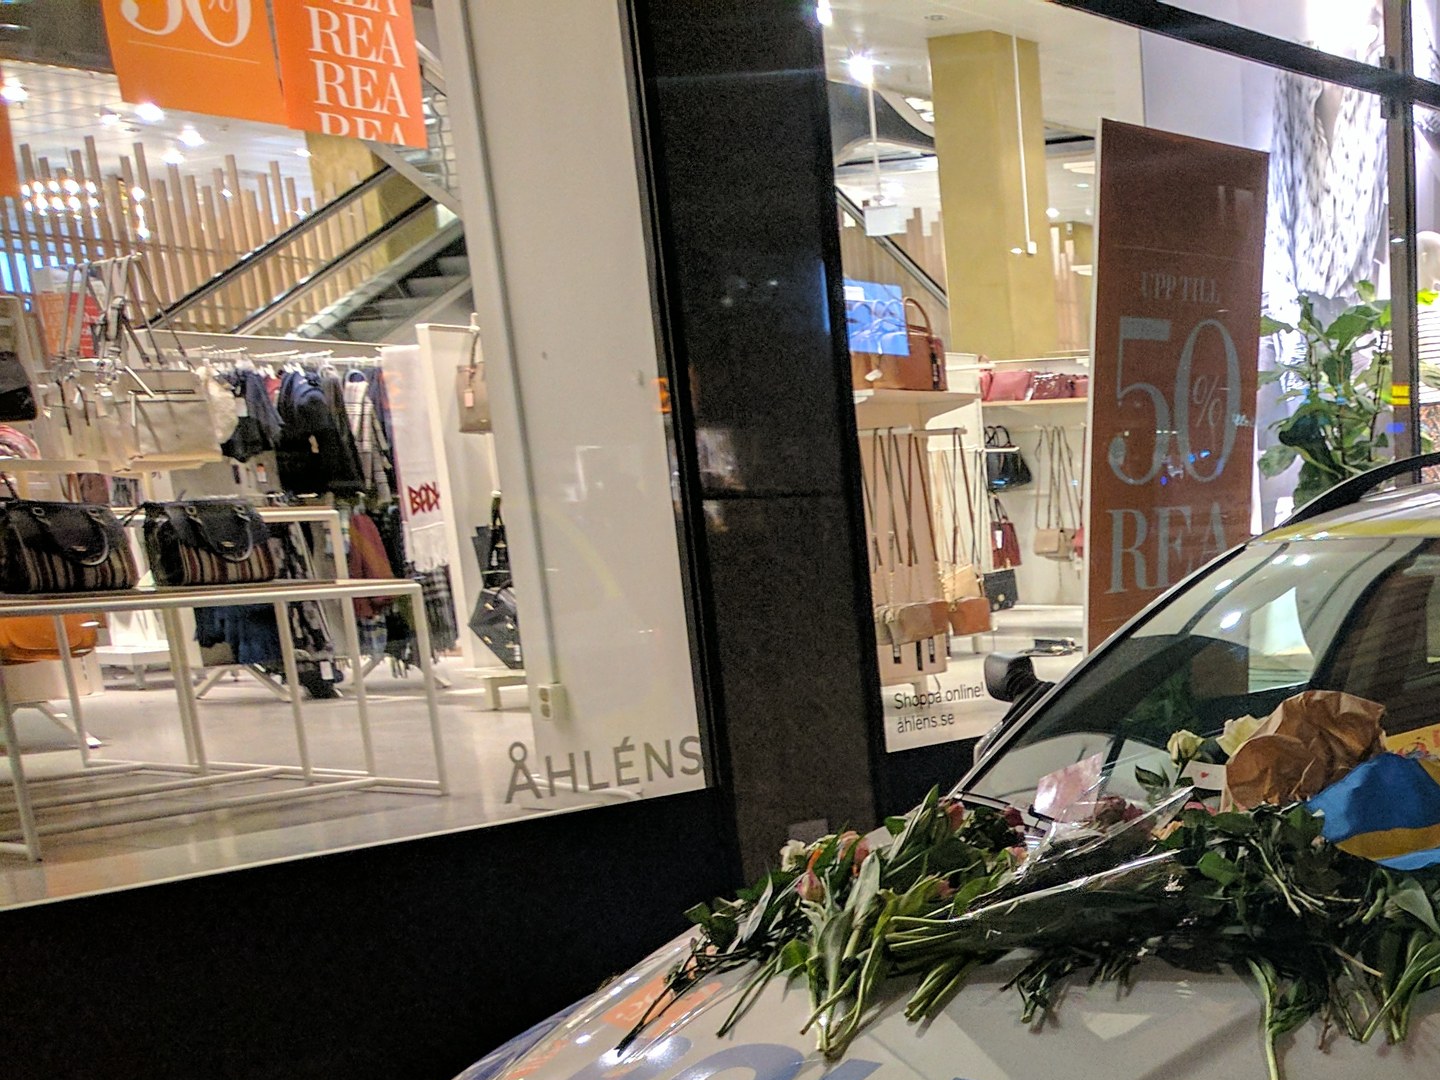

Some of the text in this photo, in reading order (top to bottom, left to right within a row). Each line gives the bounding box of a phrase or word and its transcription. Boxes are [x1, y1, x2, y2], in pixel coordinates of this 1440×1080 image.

[306, 5, 405, 68] REA
[310, 58, 410, 118] REA
[894, 682, 985, 711] Shoppa online!
[505, 736, 703, 804] ÅHLÉNS
